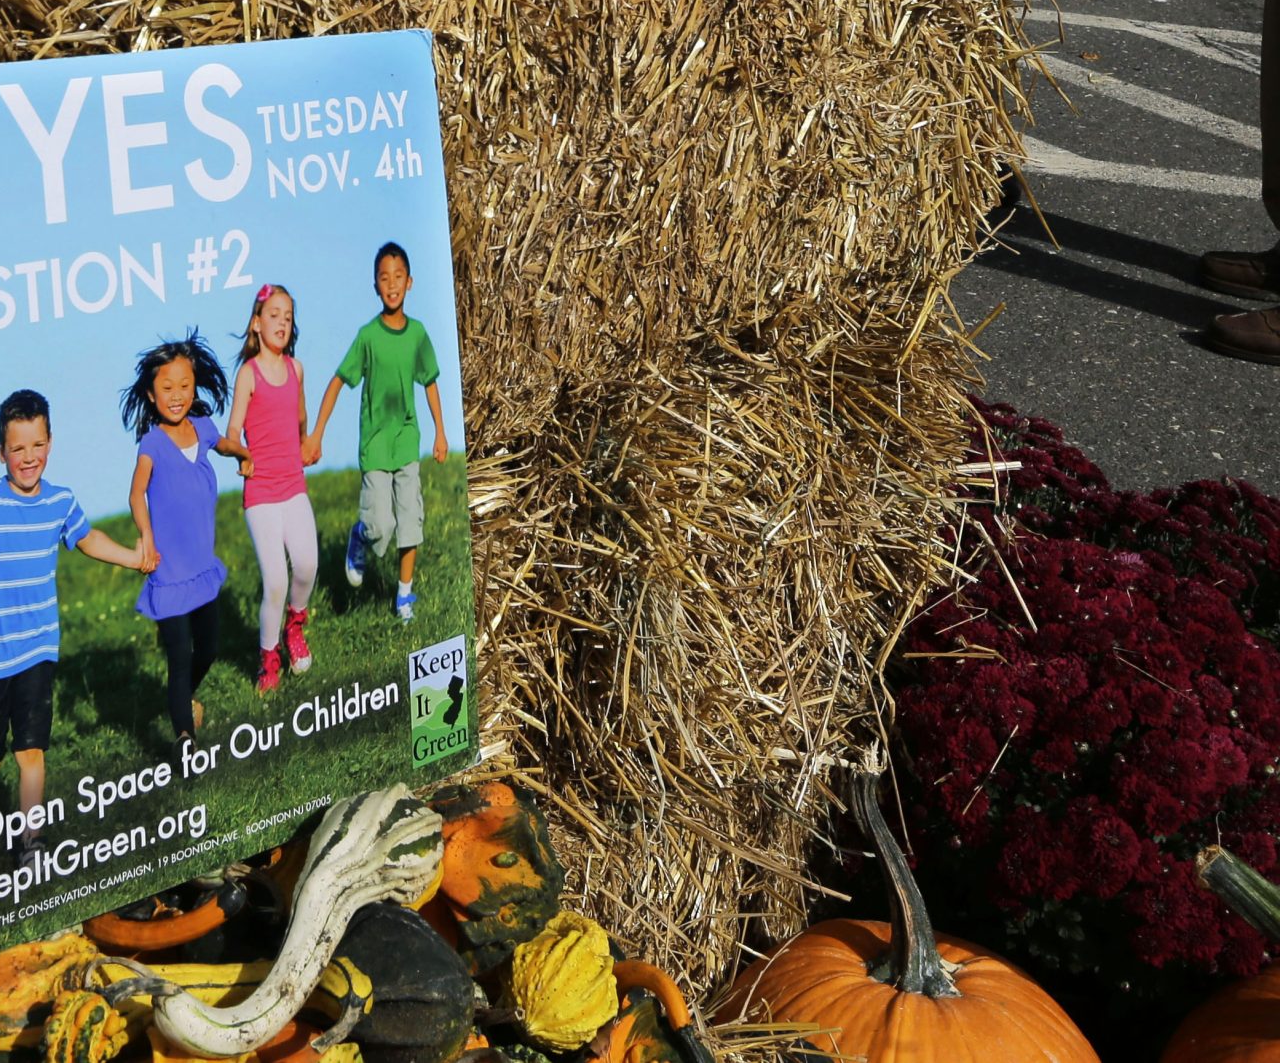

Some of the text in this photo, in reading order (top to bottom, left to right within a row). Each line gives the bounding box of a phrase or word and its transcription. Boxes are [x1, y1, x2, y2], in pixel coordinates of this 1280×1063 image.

[257, 90, 409, 144] TUESDAY
[267, 138, 424, 199] NOV. 4th
[187, 229, 253, 295] #2
[411, 648, 463, 681] Keep
[416, 693, 431, 719] It
[77, 762, 172, 823] Space
[181, 739, 220, 779] for
[230, 723, 283, 759] Our
[292, 681, 399, 738] Children
[413, 727, 467, 761] Green
[18, 882, 97, 920] CONSERVATION
[99, 865, 155, 891] CAMPAIGN,
[157, 854, 169, 869] 19
[171, 837, 219, 863] BOONTON
[246, 812, 291, 835] BOONTON
[293, 806, 304, 820] NJ
[306, 794, 332, 813] 07005
